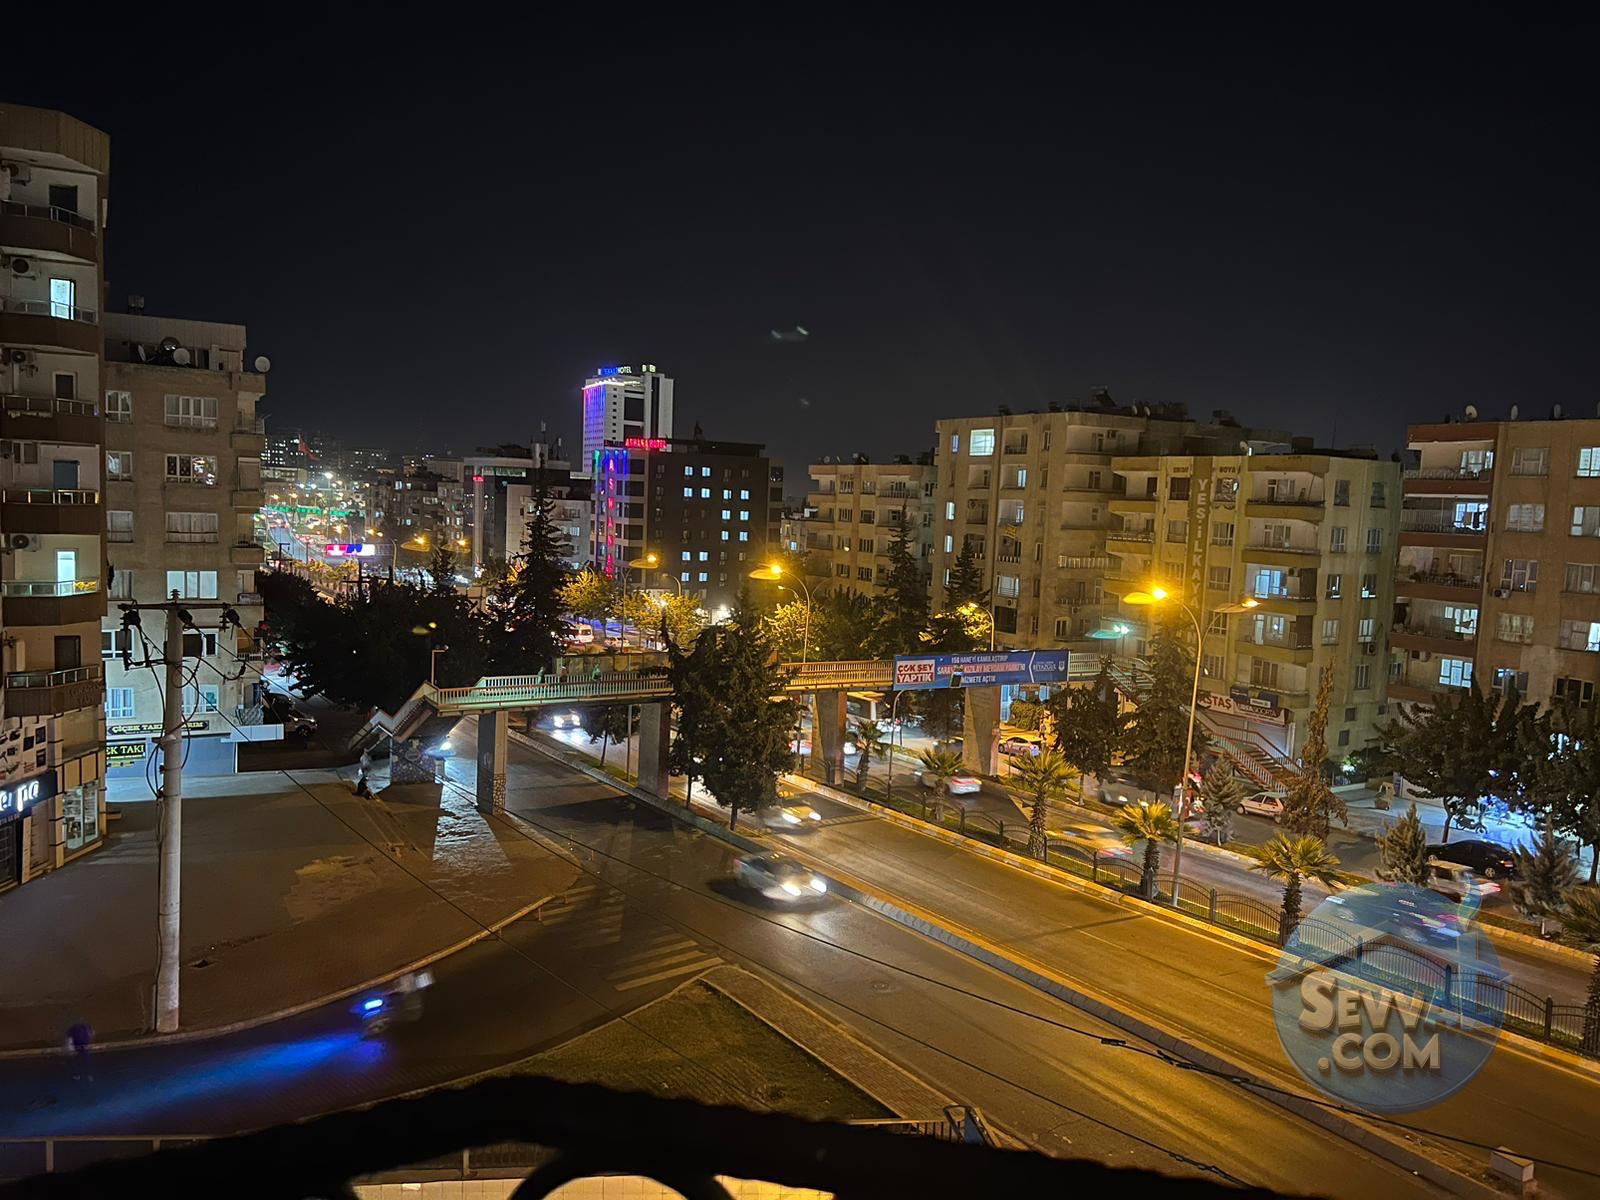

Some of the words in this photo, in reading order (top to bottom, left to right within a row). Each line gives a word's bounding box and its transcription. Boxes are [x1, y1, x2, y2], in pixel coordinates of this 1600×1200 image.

[617, 366, 632, 374] HOTEL
[898, 664, 915, 674] ÇOK
[917, 663, 933, 673] ŞEY
[898, 673, 932, 683] YAPTIK
[112, 724, 140, 734] ÇİÇEK
[120, 745, 144, 754] TAKI
